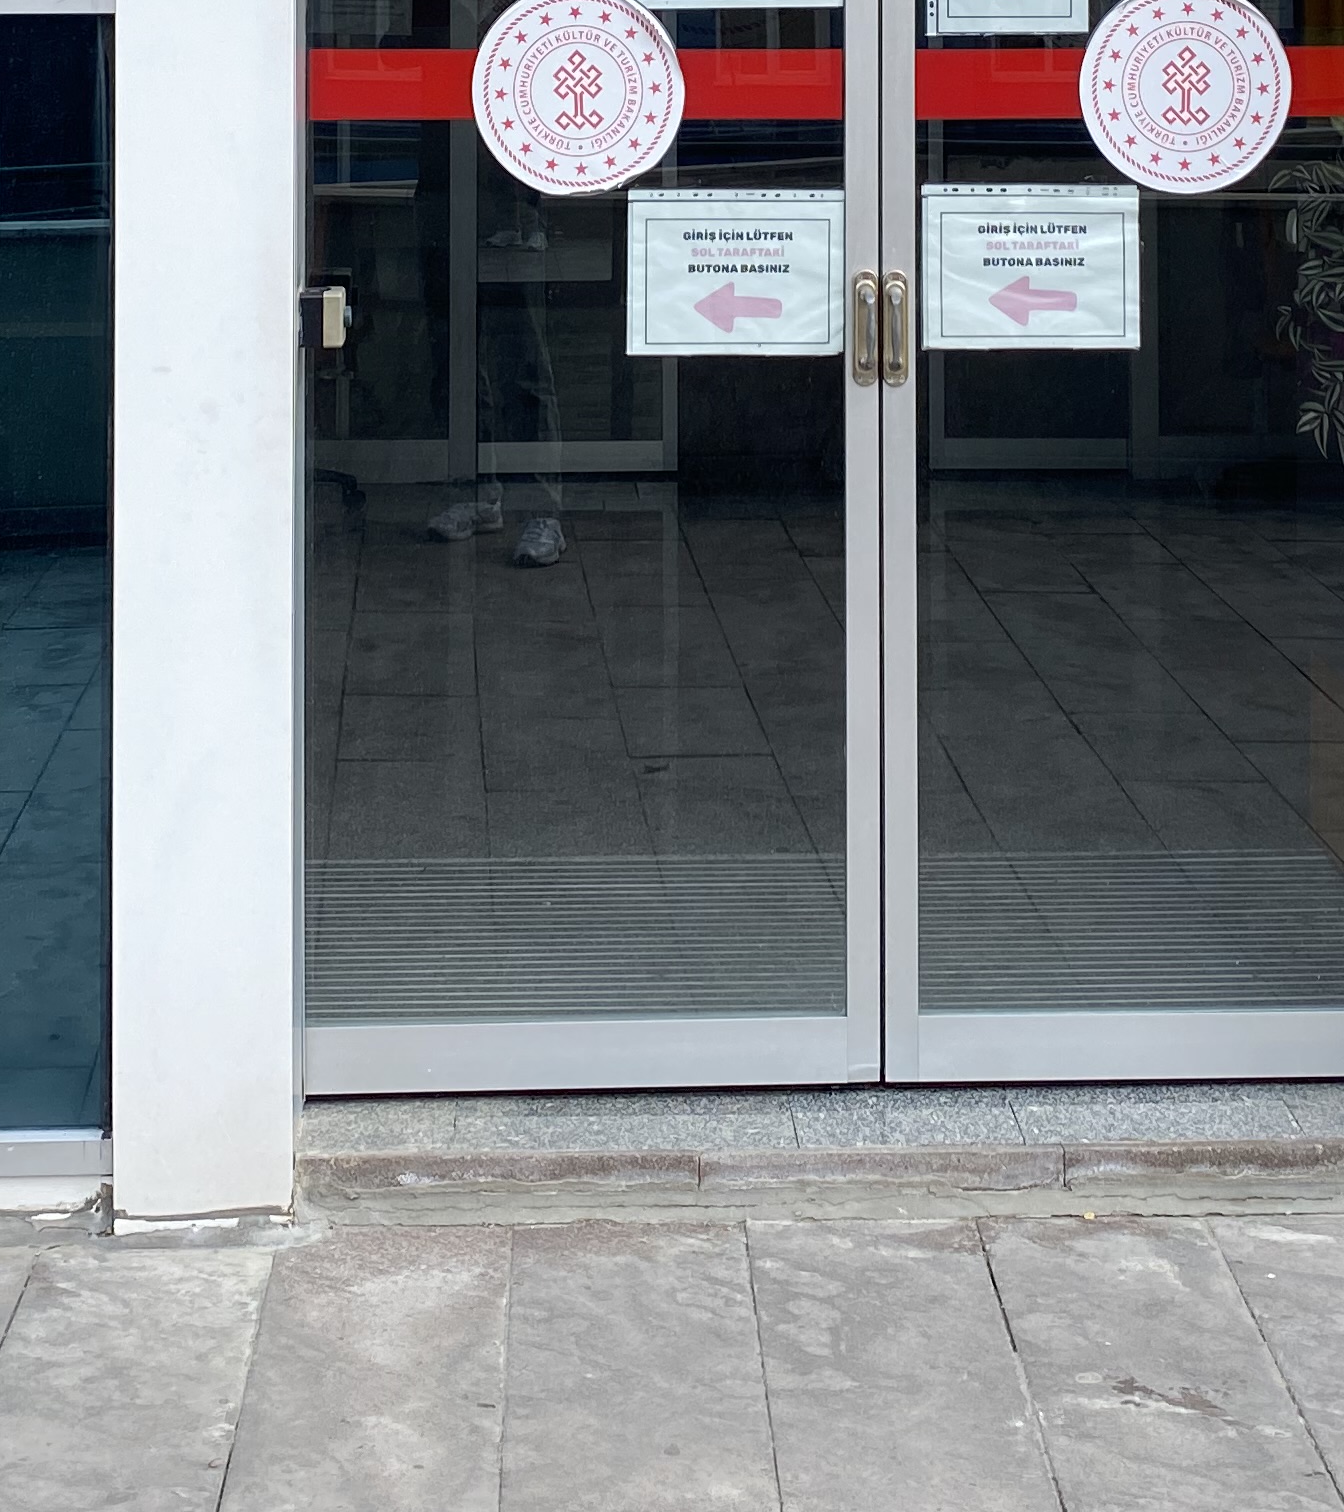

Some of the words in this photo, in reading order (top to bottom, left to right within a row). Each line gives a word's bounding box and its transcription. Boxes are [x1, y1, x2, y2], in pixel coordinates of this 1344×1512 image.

[554, 29, 601, 44] KÜLTÜR
[1166, 25, 1212, 41] KÜLTÜR
[602, 36, 617, 52] VE
[1214, 34, 1227, 51] VE
[519, 38, 554, 116] CUMHURİYETİ
[616, 50, 638, 95] TURİZM
[1127, 33, 1165, 108] CUMHURİYETİ
[1227, 49, 1246, 94] TURİZM
[590, 99, 638, 150] BAKANLIĞI
[1134, 110, 1176, 146] TÜRKİYE
[1195, 96, 1246, 145] BAKANLIĞI
[527, 116, 571, 152] TÜRKİYE
[683, 229, 717, 243] GİRİŞ
[719, 229, 744, 243] İÇİN
[746, 229, 793, 241] LÜTFEN
[978, 223, 1011, 236] GİRİŞ
[1013, 223, 1038, 235] İÇİN
[1040, 222, 1087, 234] LÜTFEN
[691, 248, 715, 257] SOL
[717, 246, 785, 257] TARAFTAKİ
[986, 241, 1010, 250] SOL
[1011, 239, 1079, 250] TARAFTAKİ
[688, 264, 738, 273] BUTONA
[741, 264, 790, 273] BASINIZ
[983, 258, 1033, 266] BUTONA
[1036, 258, 1085, 266] BASINIZ
